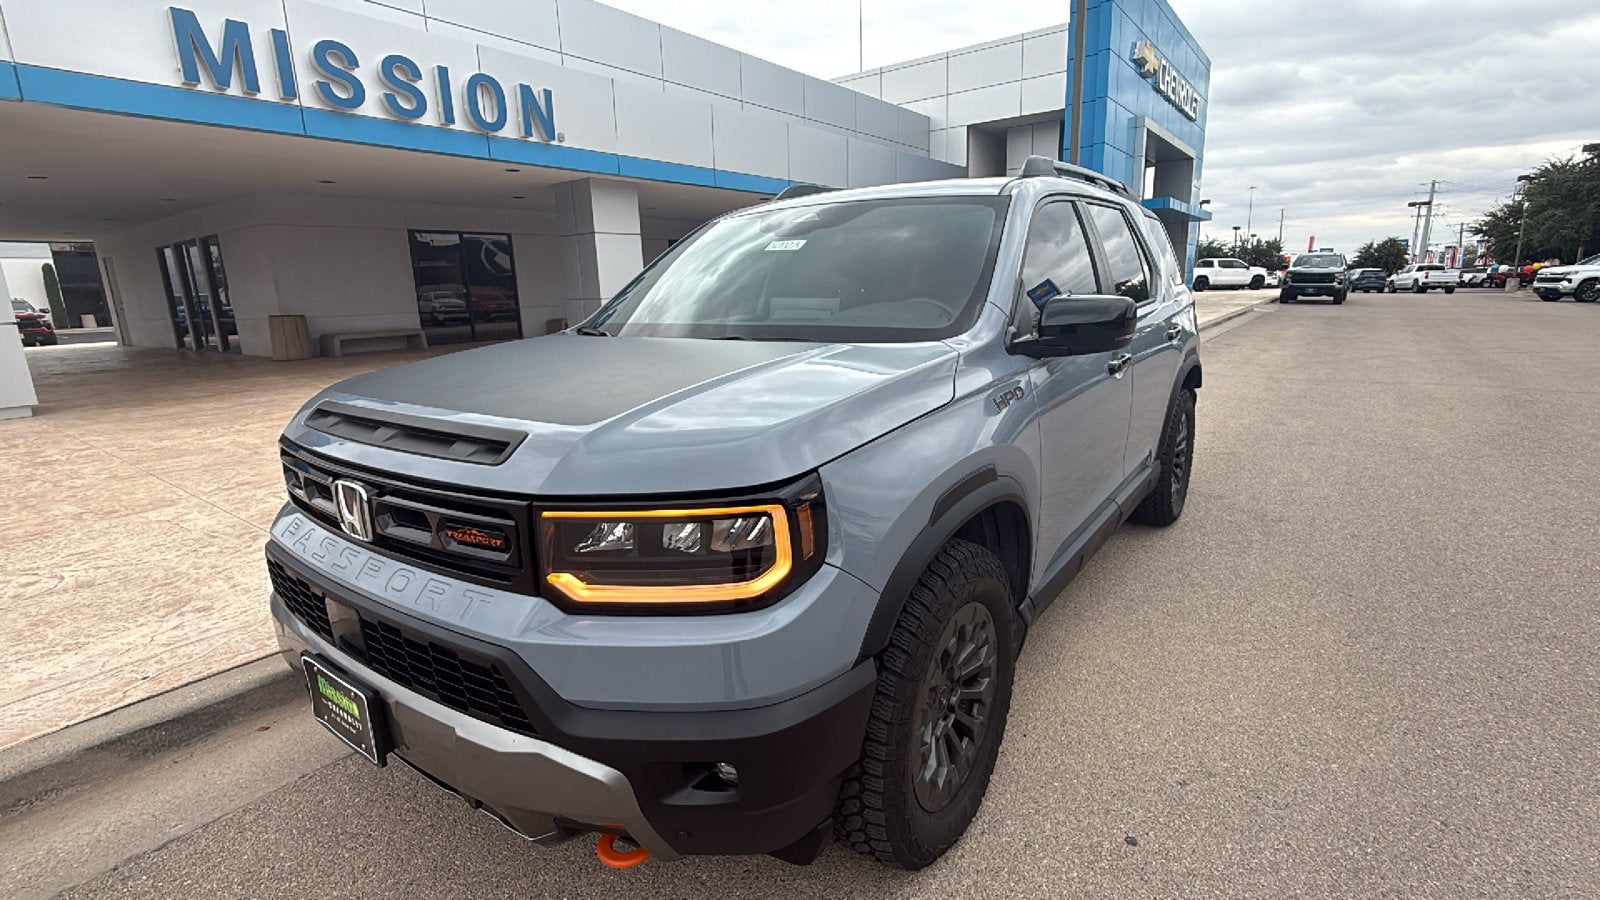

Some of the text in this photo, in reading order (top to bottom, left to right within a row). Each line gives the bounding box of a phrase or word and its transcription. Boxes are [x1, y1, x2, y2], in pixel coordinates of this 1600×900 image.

[168, 6, 556, 141] MISSION
[1159, 58, 1201, 120] CHEVROLET
[992, 386, 1025, 413] HPD
[280, 517, 495, 619] PASSPORT
